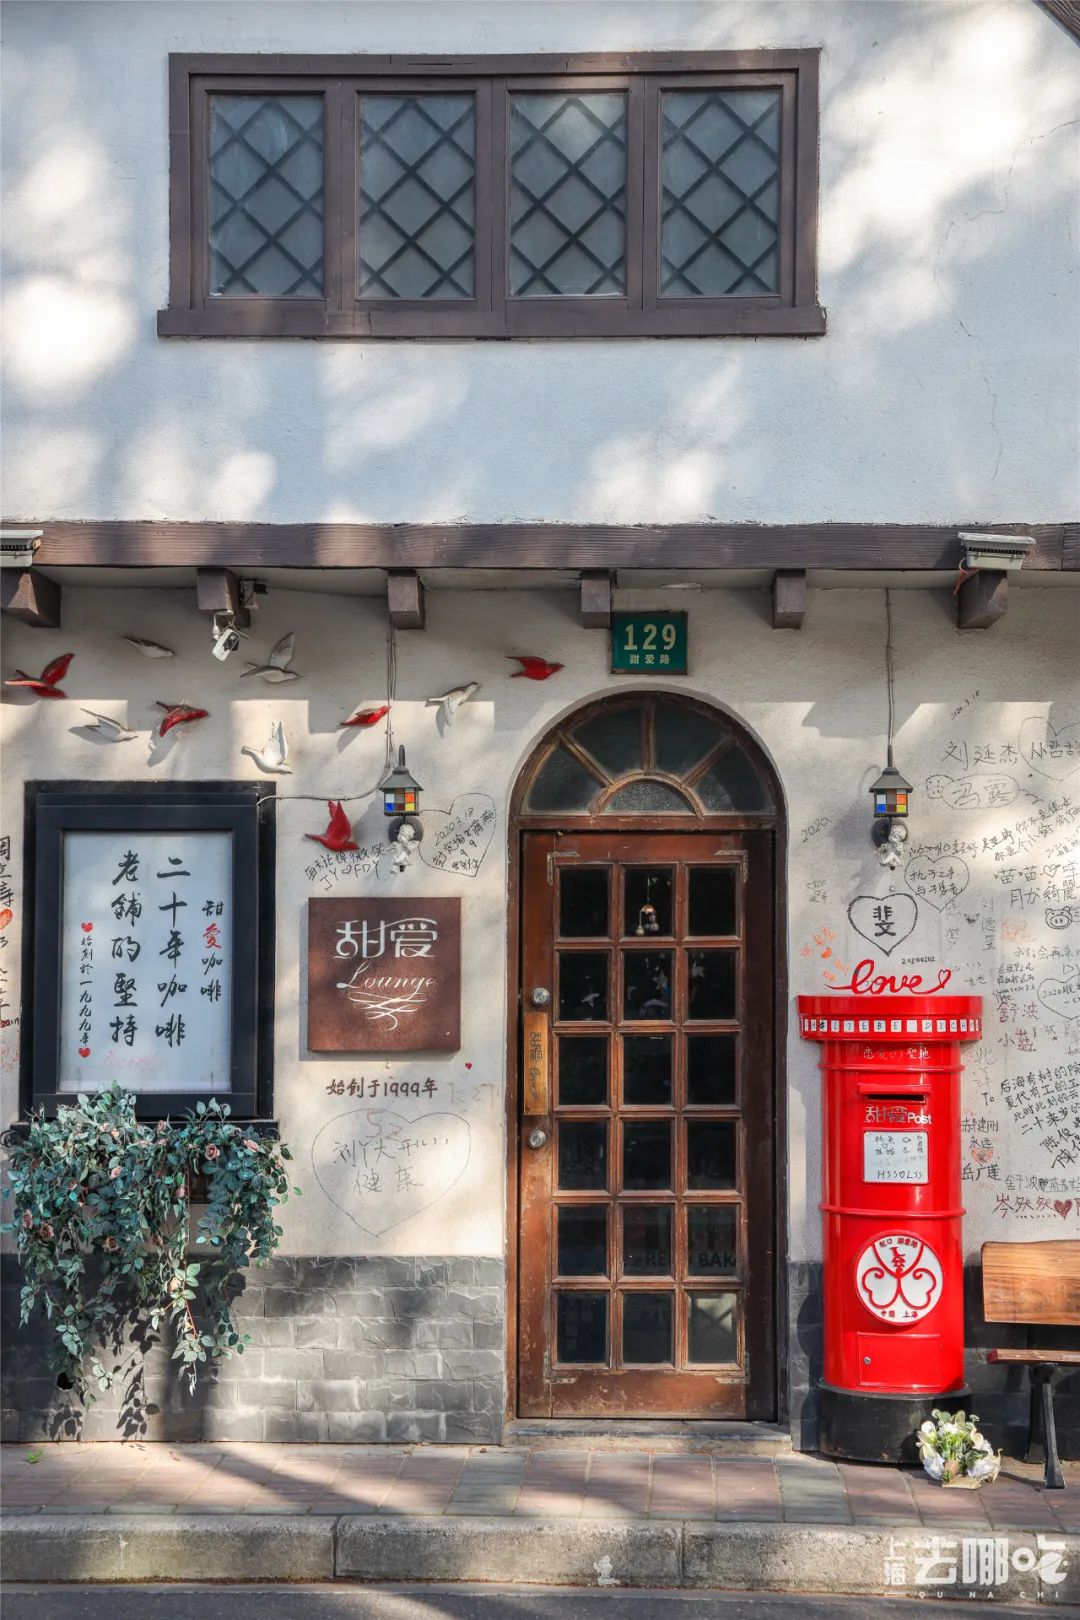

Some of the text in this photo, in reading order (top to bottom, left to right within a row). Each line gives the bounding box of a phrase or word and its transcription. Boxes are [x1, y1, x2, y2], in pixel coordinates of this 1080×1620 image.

[624, 623, 676, 650] 129
[629, 654, 670, 664] 甜爱路
[333, 917, 438, 959] 甜爱
[336, 960, 437, 1001] Lounge
[826, 959, 932, 995] love
[326, 1076, 438, 1099] 始创于1999年
[981, 1092, 995, 1106] To
